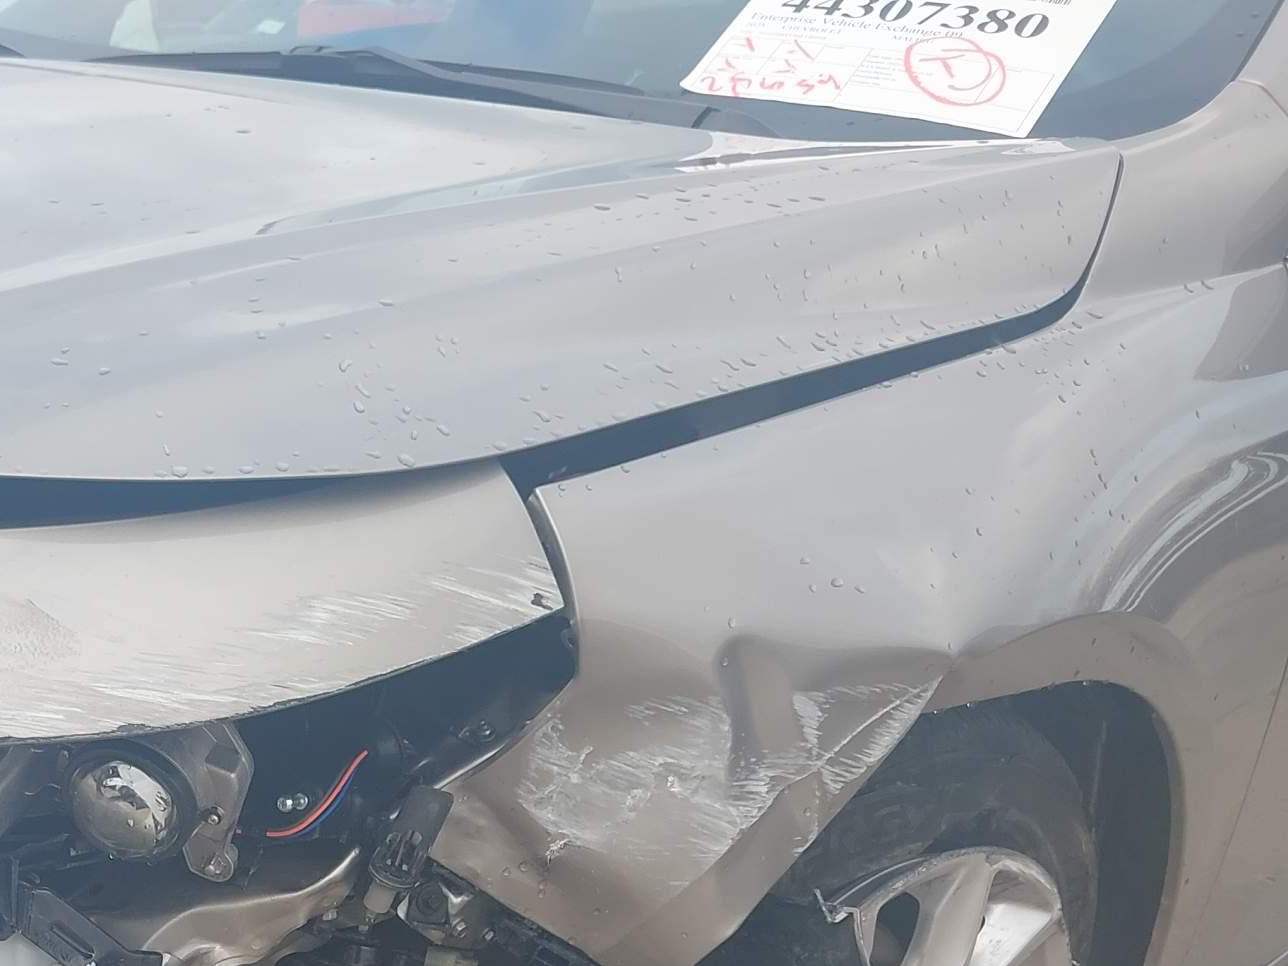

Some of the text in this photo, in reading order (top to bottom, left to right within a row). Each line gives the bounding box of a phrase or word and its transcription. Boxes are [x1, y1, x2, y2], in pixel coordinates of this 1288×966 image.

[750, 11, 818, 25] Enterprise
[822, 17, 872, 30] Vehicle
[874, 22, 943, 38] Exchange
[781, 0, 1050, 38] 44307380
